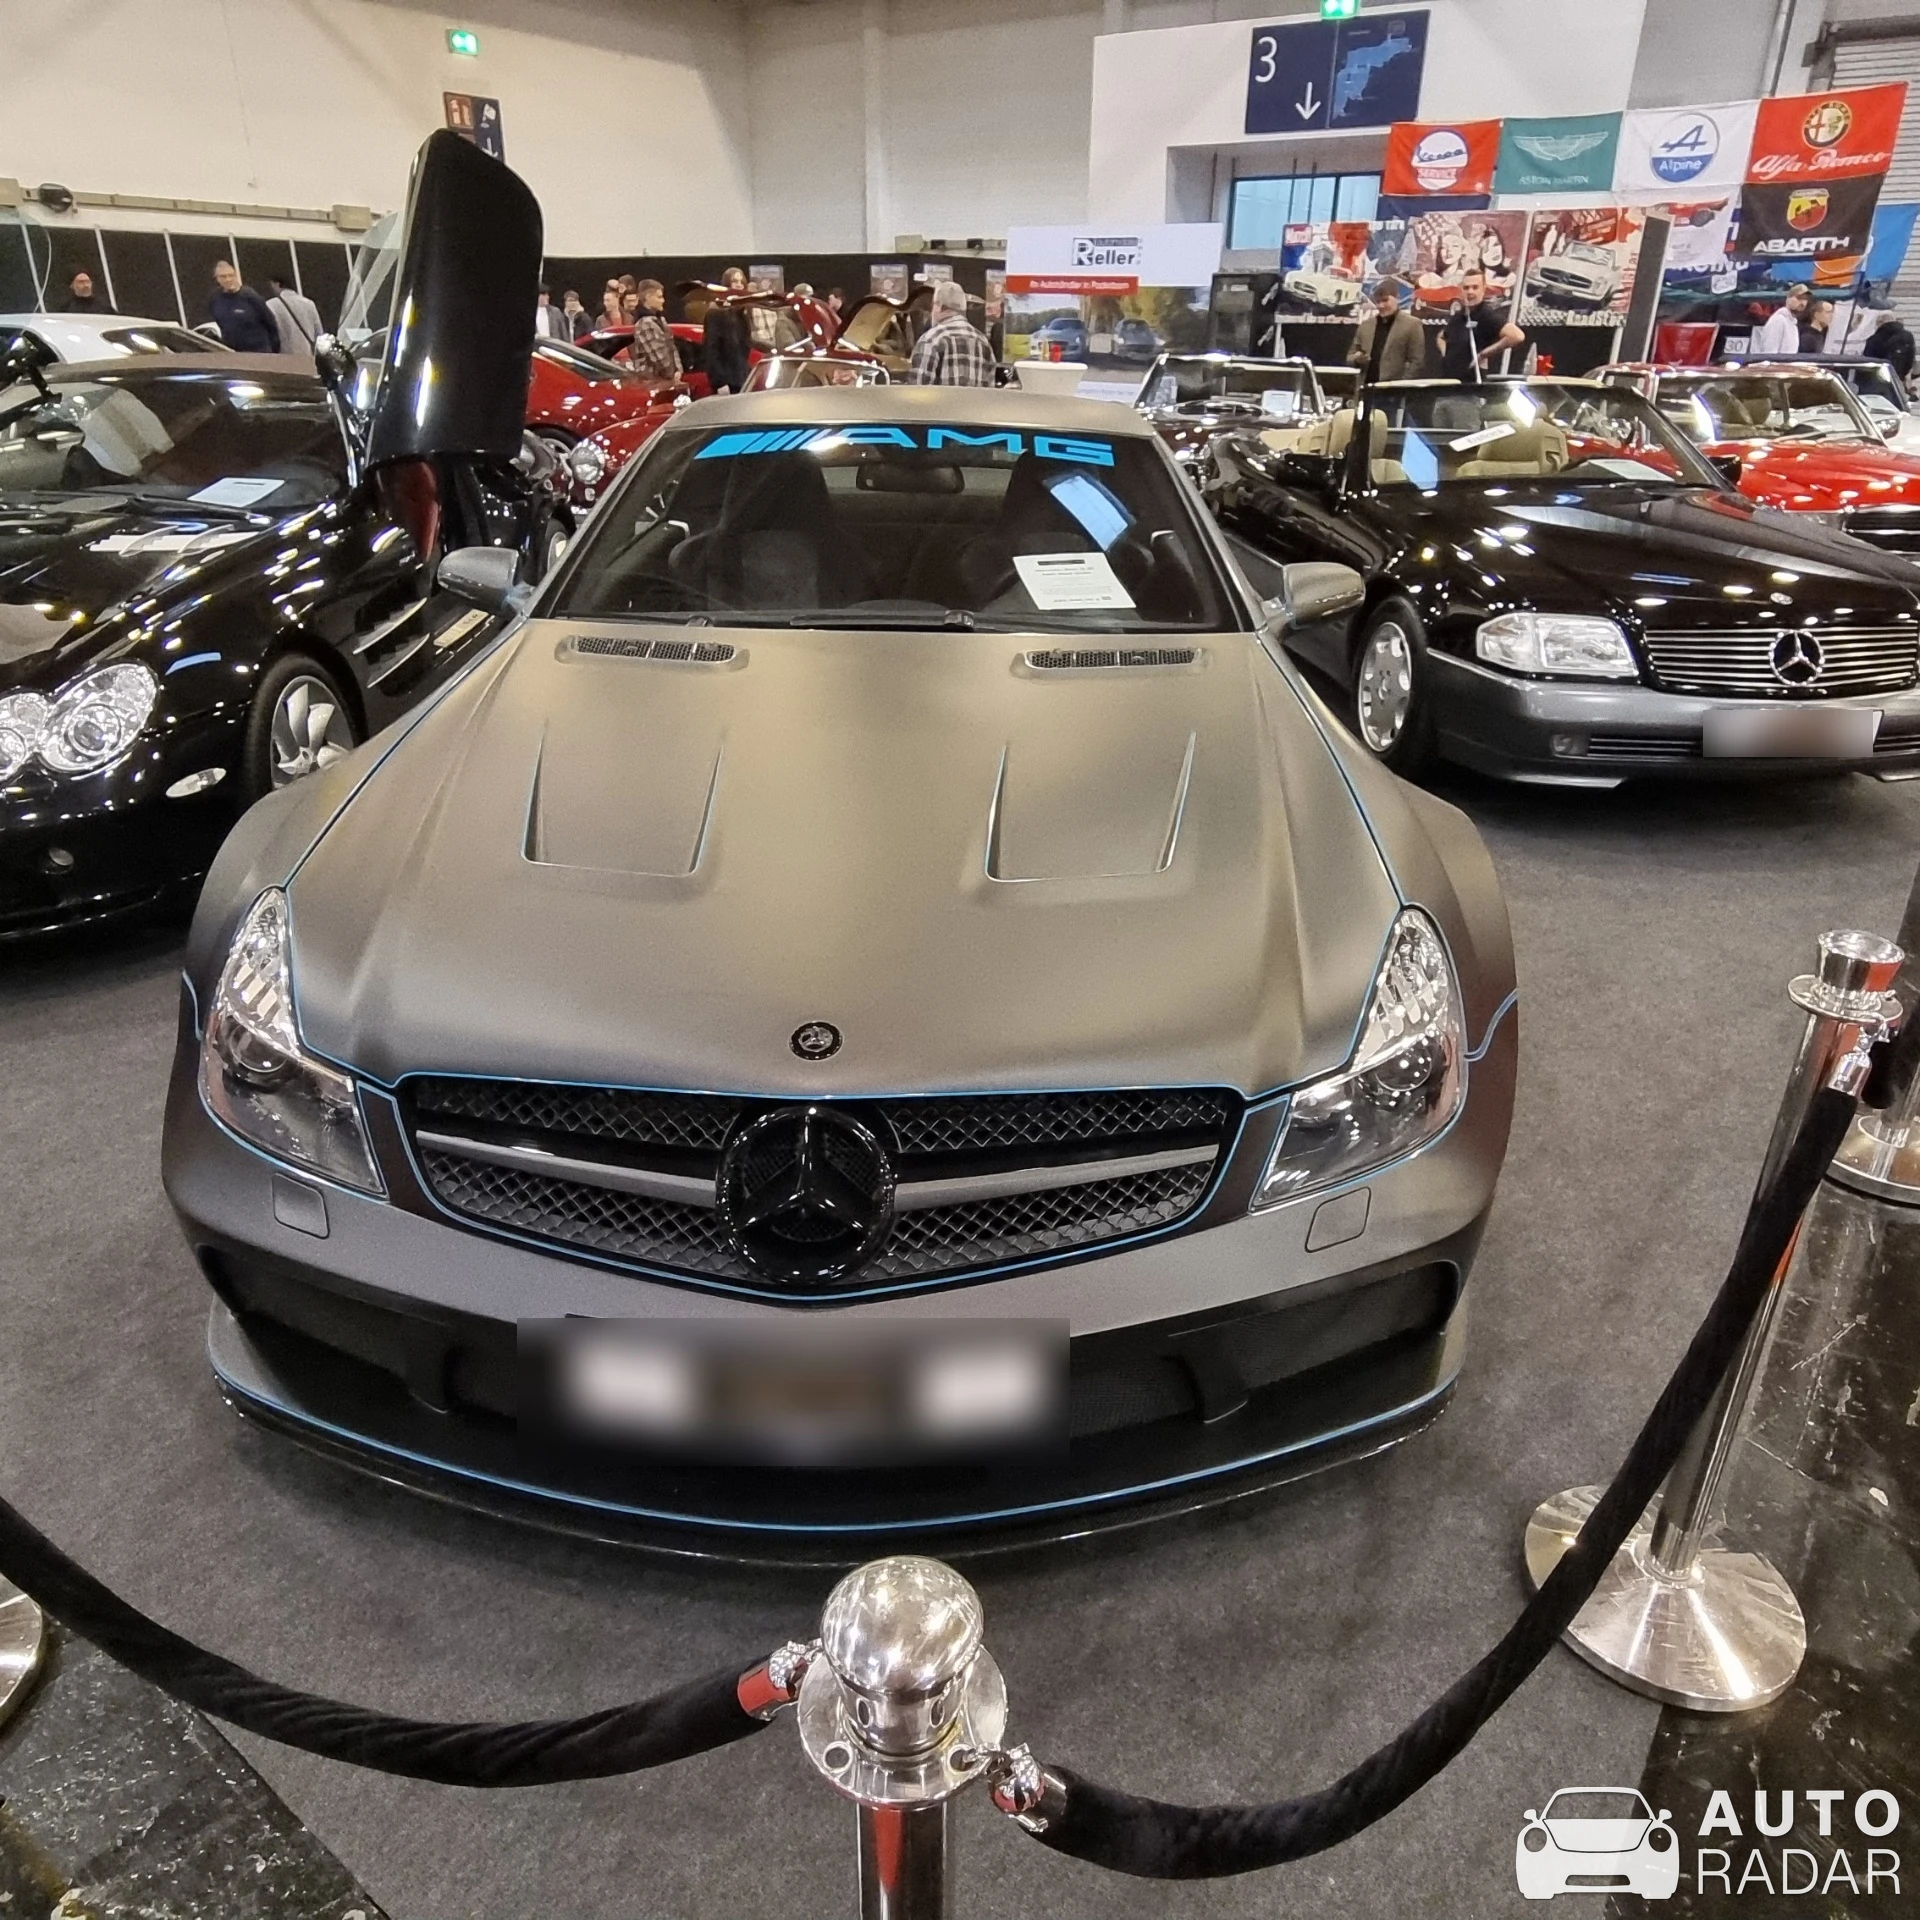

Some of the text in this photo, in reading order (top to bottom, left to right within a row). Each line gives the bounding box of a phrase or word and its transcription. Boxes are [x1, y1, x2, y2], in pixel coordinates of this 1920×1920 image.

[1254, 35, 1278, 83] 3
[1518, 174, 1589, 185] ASTON MARTIN
[1659, 158, 1703, 174] Alpine
[1751, 152, 1804, 181] Alfa
[1073, 237, 1136, 266] Reller
[1753, 236, 1850, 253] ABARTH
[806, 427, 1115, 467] AMG
